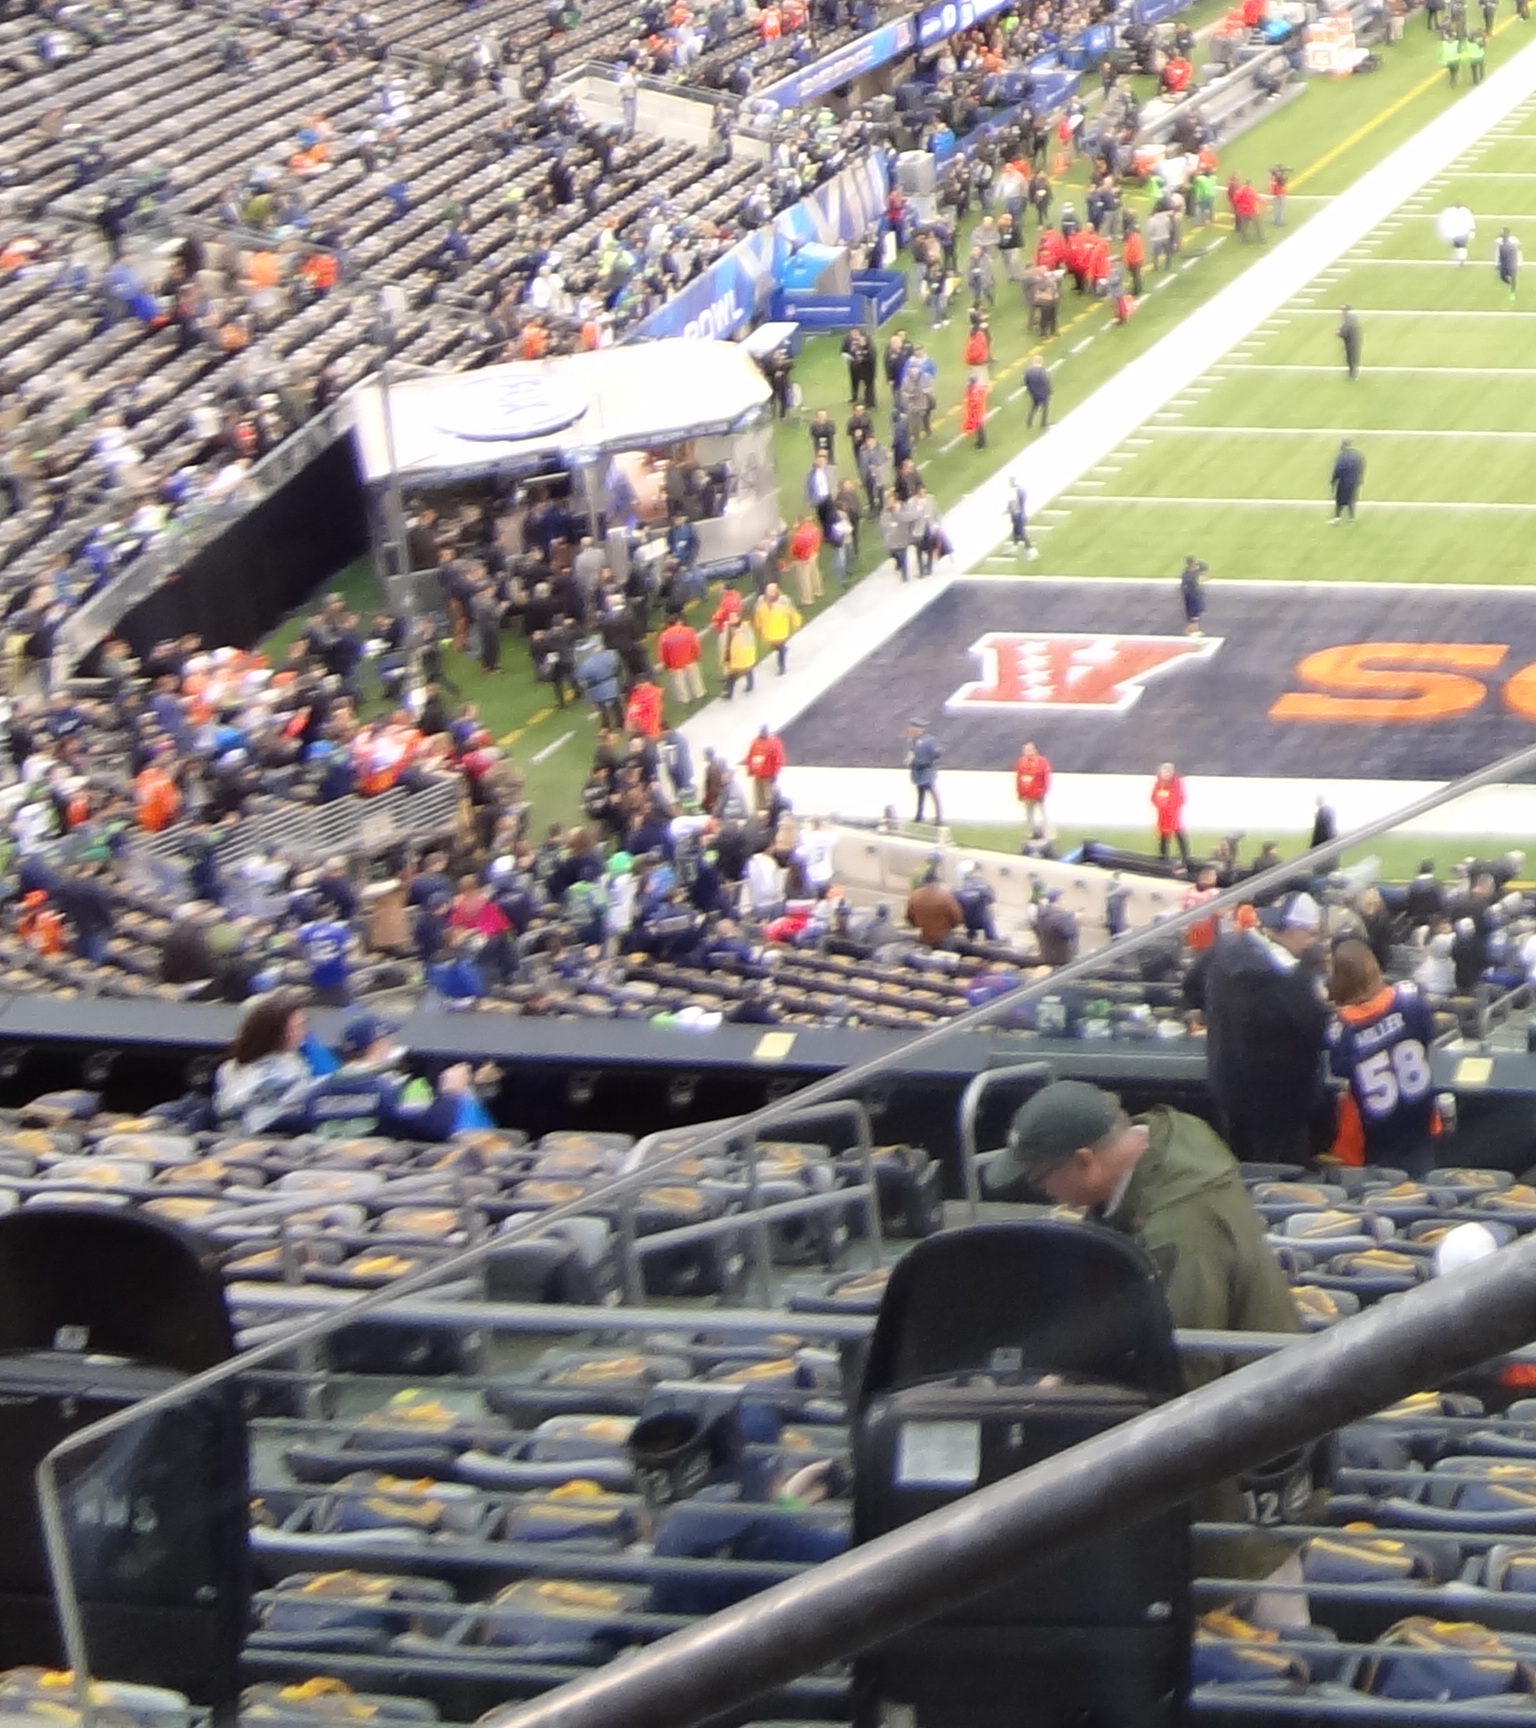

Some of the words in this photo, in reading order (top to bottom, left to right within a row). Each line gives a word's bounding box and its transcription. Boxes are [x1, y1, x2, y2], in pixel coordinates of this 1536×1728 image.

[684, 289, 744, 340] BOWL
[1354, 1012, 1405, 1047] MILLER
[1356, 1039, 1431, 1114] 58
[1242, 1490, 1280, 1524] 12
